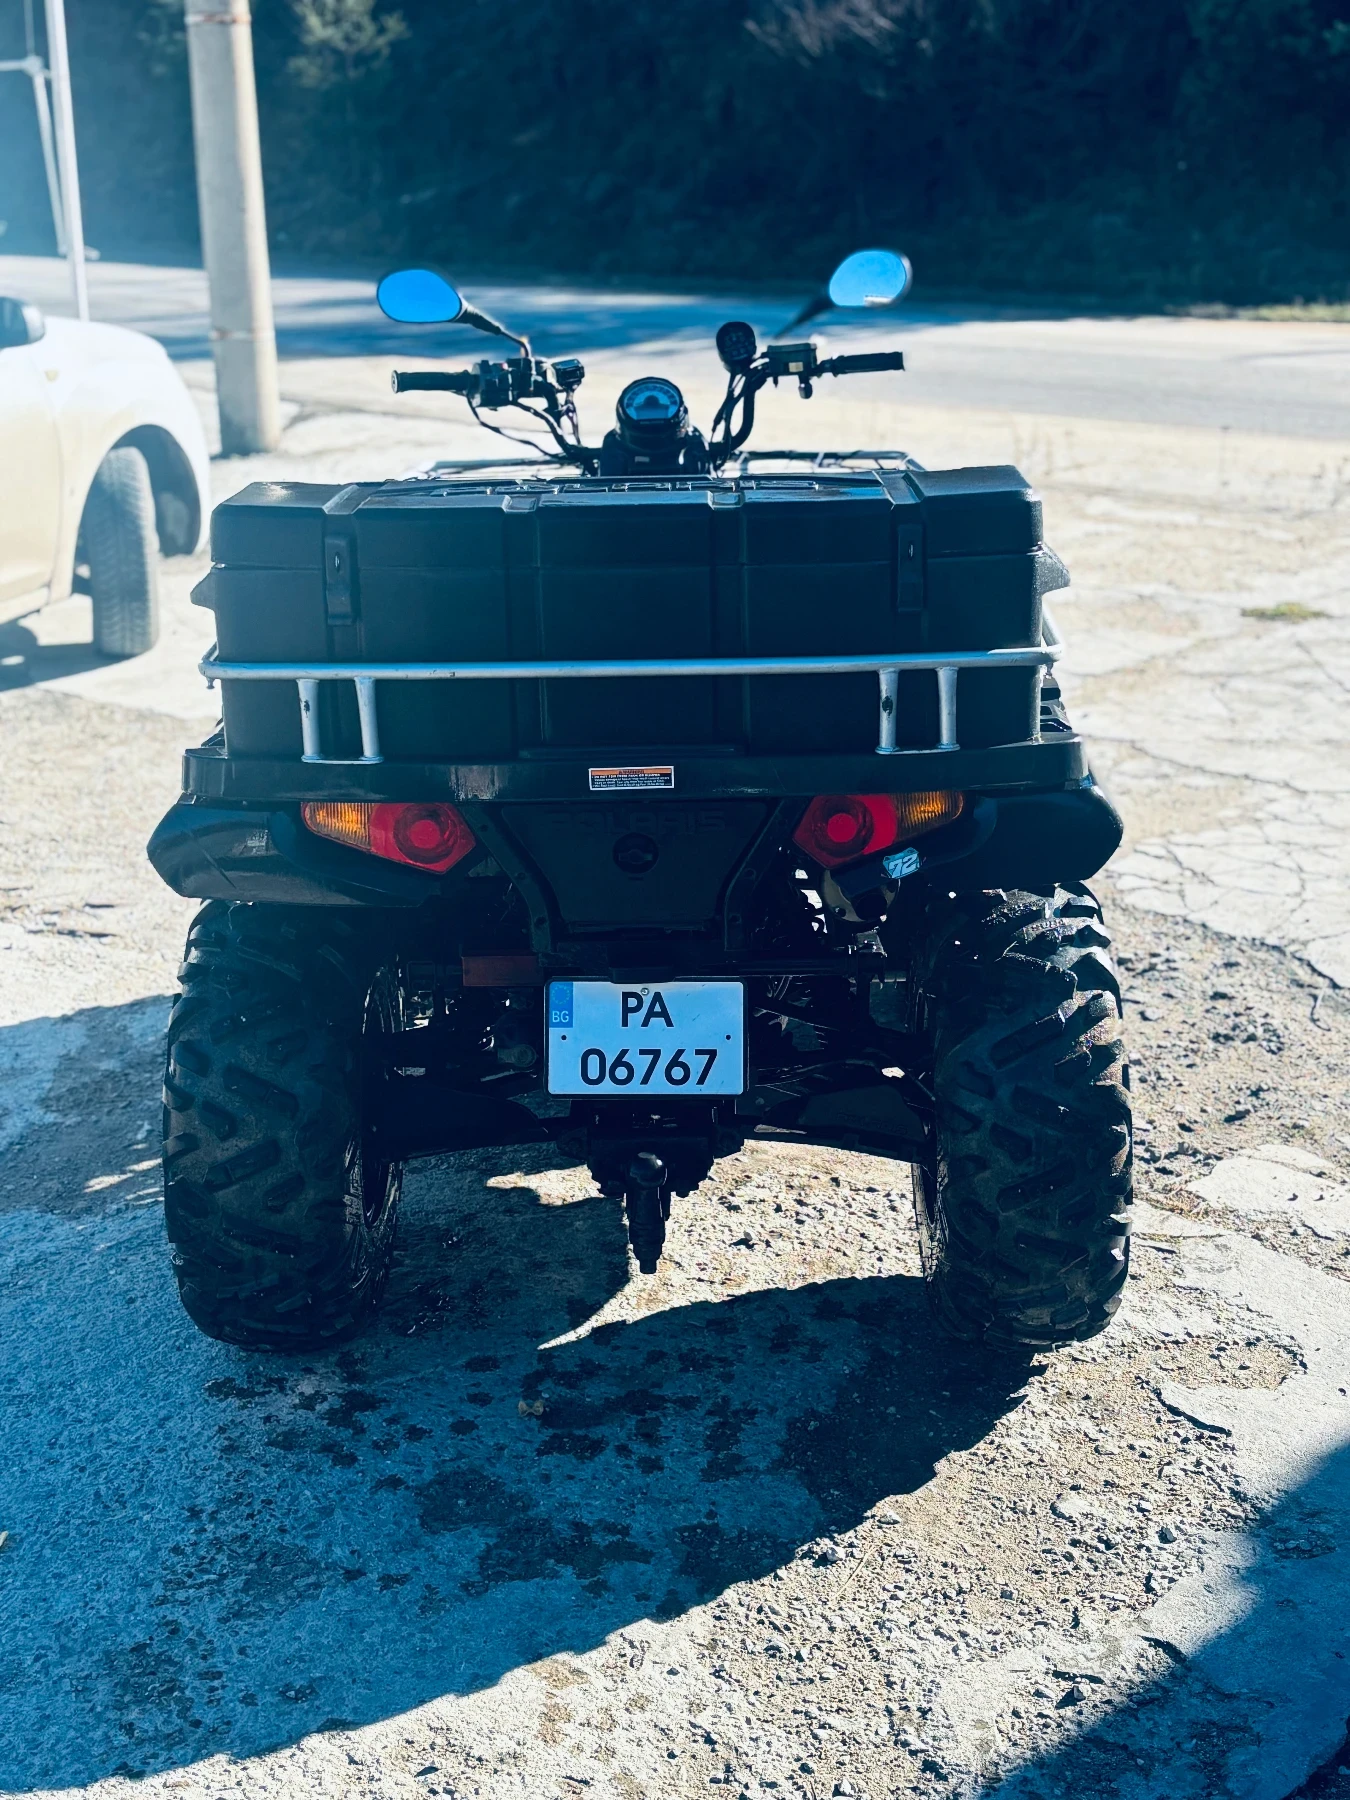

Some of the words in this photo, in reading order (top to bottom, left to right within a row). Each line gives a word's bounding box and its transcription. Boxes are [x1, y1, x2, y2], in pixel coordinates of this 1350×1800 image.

[552, 1010, 570, 1023] BG
[621, 991, 675, 1028] PA
[580, 1047, 718, 1086] 06767
